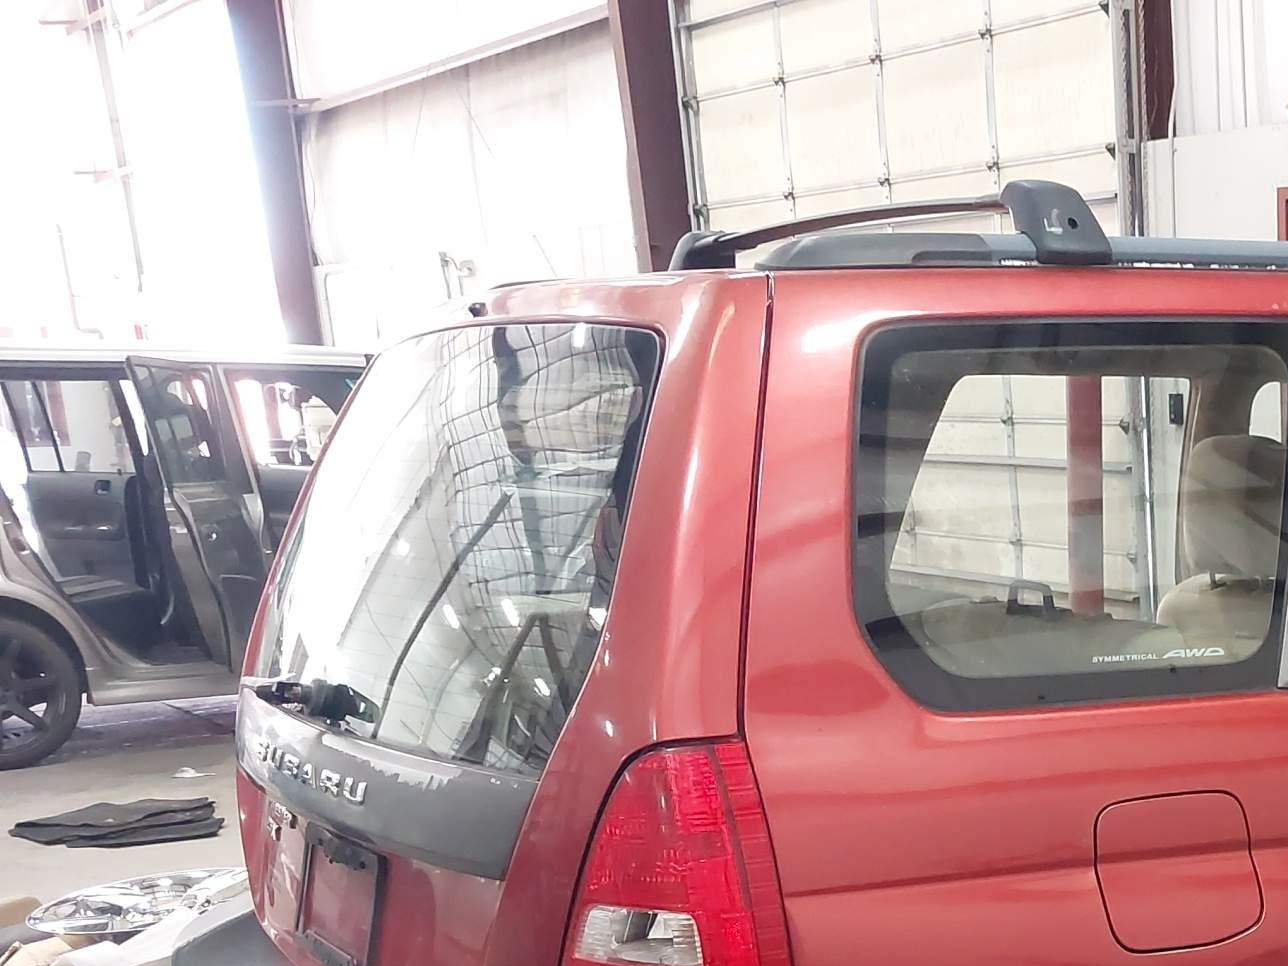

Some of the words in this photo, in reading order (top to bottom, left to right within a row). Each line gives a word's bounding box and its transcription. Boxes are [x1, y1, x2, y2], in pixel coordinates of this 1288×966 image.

[1091, 653, 1160, 664] SYMMETRICAL
[1161, 647, 1225, 660] AWD
[255, 739, 368, 806] SUBARU
